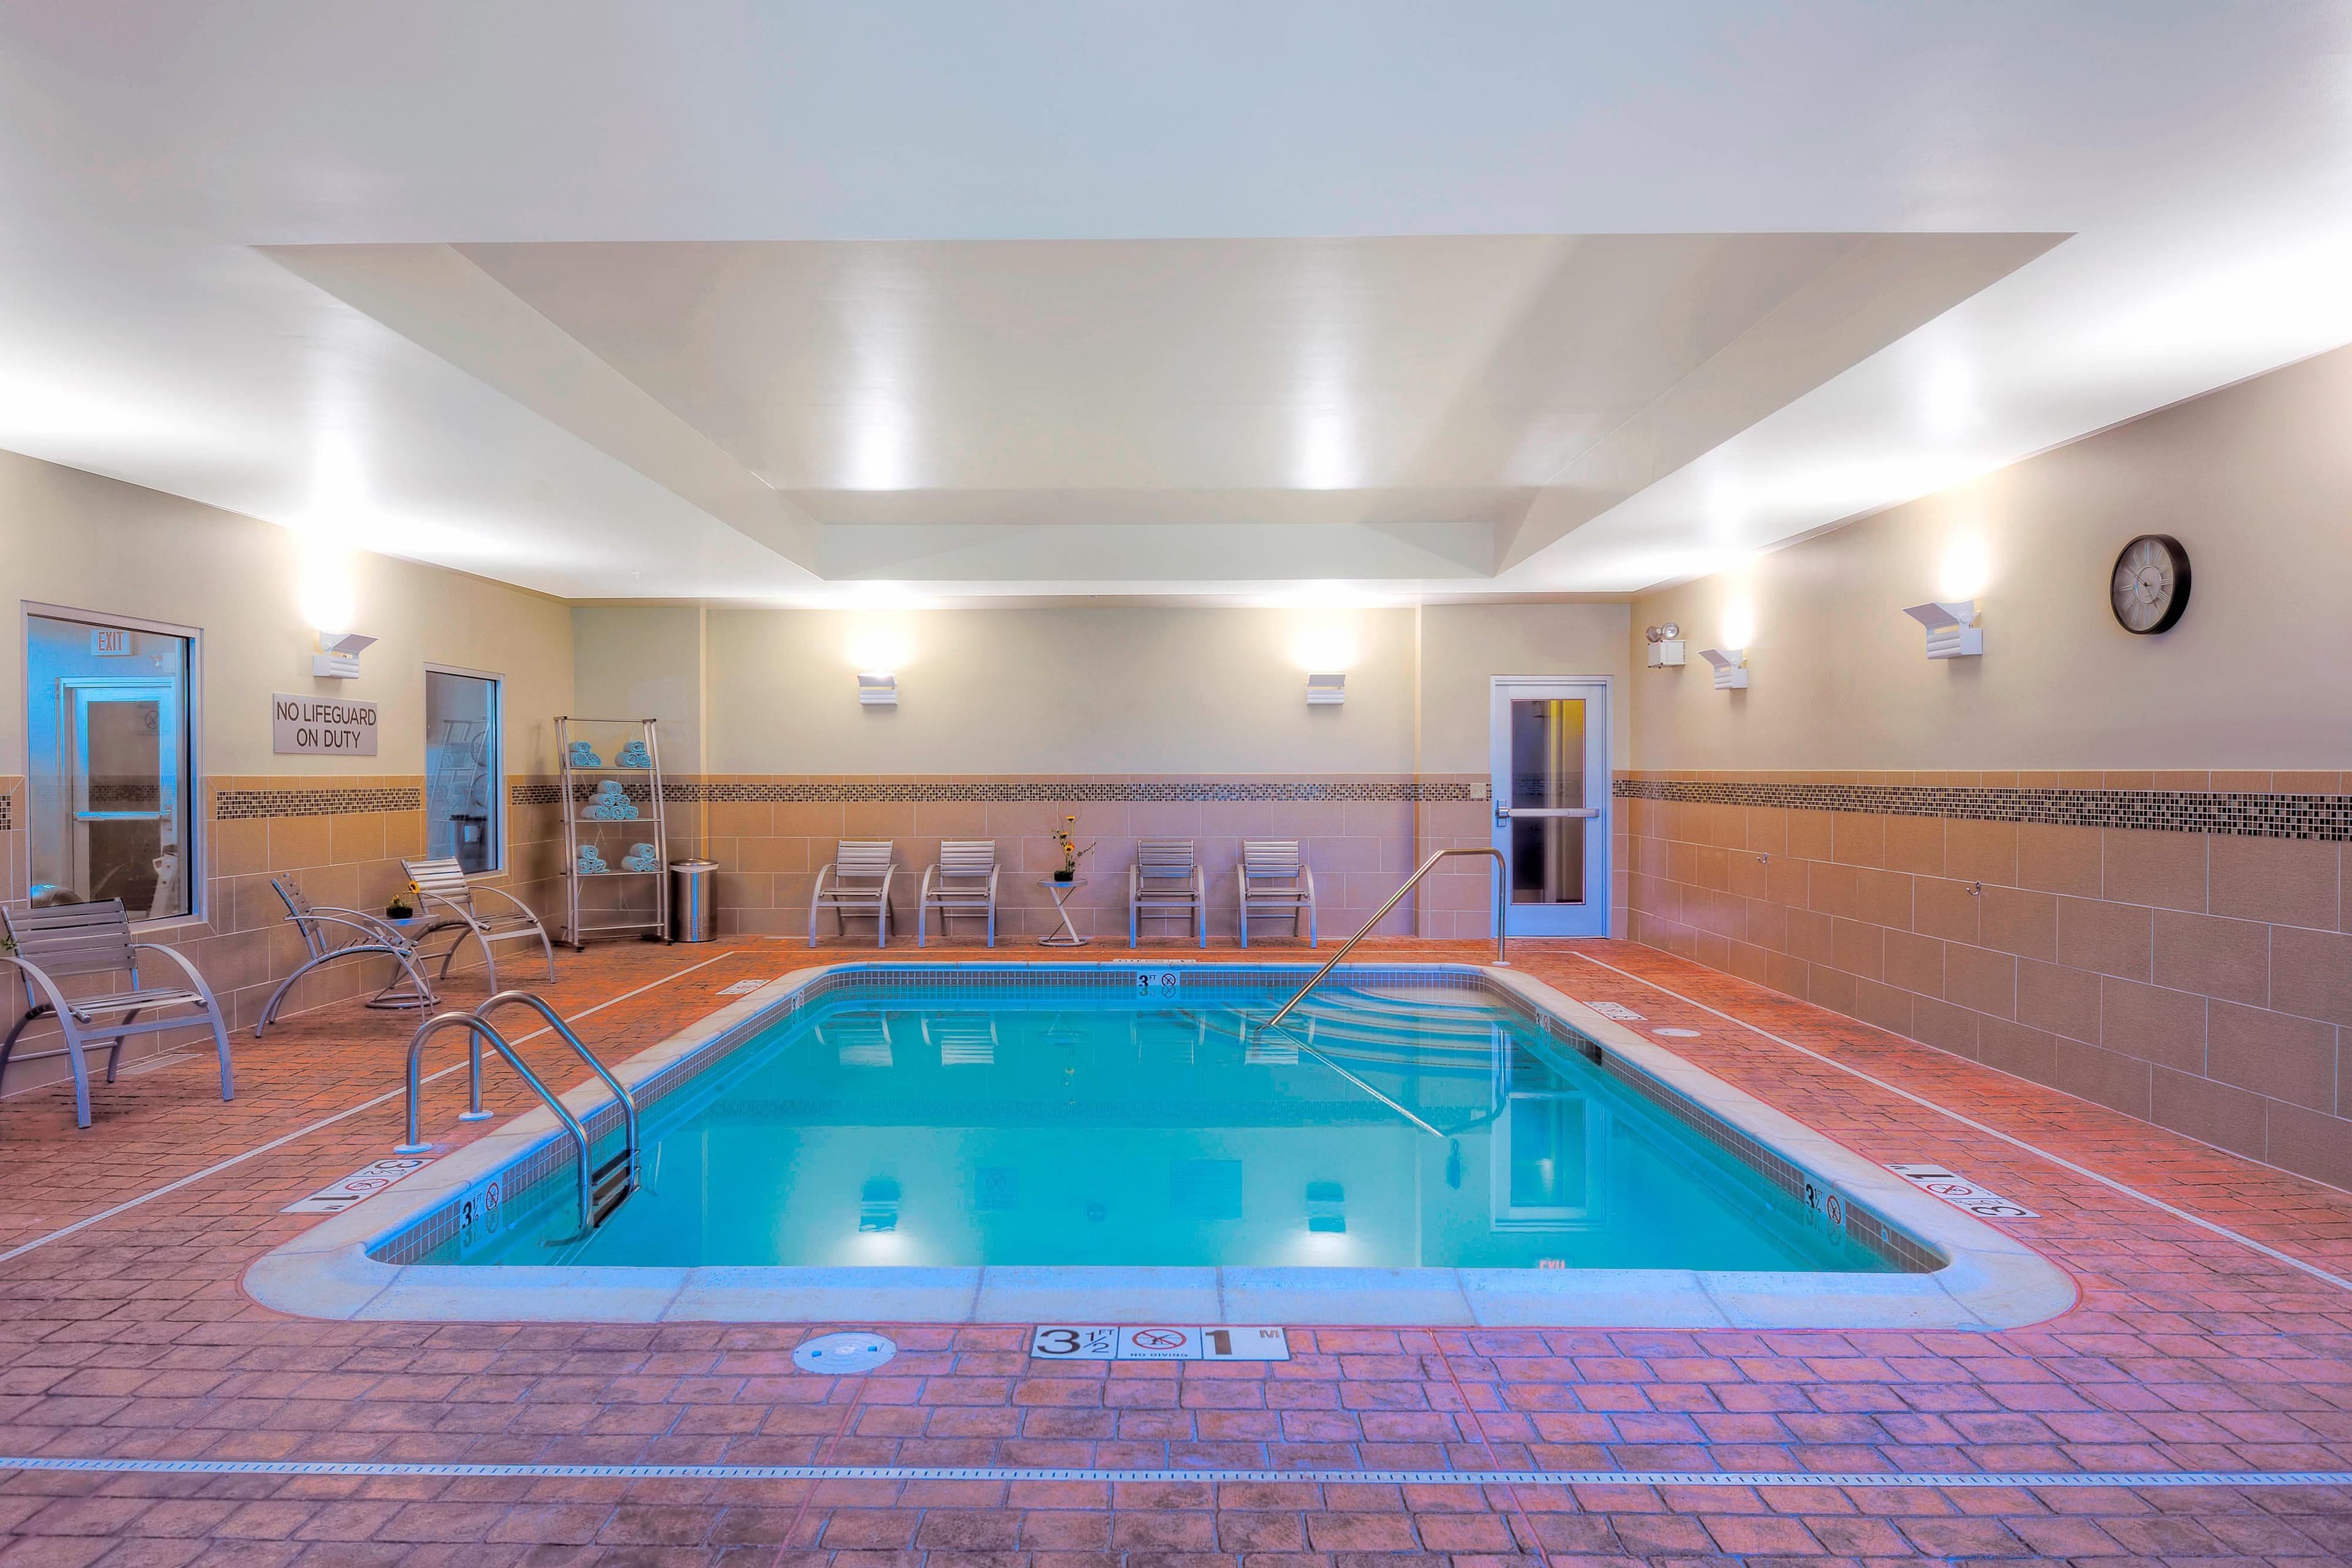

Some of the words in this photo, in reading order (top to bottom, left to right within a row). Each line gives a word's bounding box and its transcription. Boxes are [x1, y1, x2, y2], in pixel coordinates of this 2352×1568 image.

[98, 631, 123, 651] EXIT
[277, 701, 300, 722] NO
[304, 704, 377, 726] LIFEGUARD
[296, 728, 318, 747] ON
[324, 729, 361, 748] DUTY
[1139, 974, 1148, 987] 3
[374, 1160, 423, 1169] 3
[1806, 1183, 1815, 1209] 3
[462, 1201, 472, 1229] 3
[1970, 1206, 2027, 1216] 3
[1037, 1329, 1081, 1354] 3
[1205, 1330, 1232, 1355] 1
[1259, 1329, 1281, 1339] M
